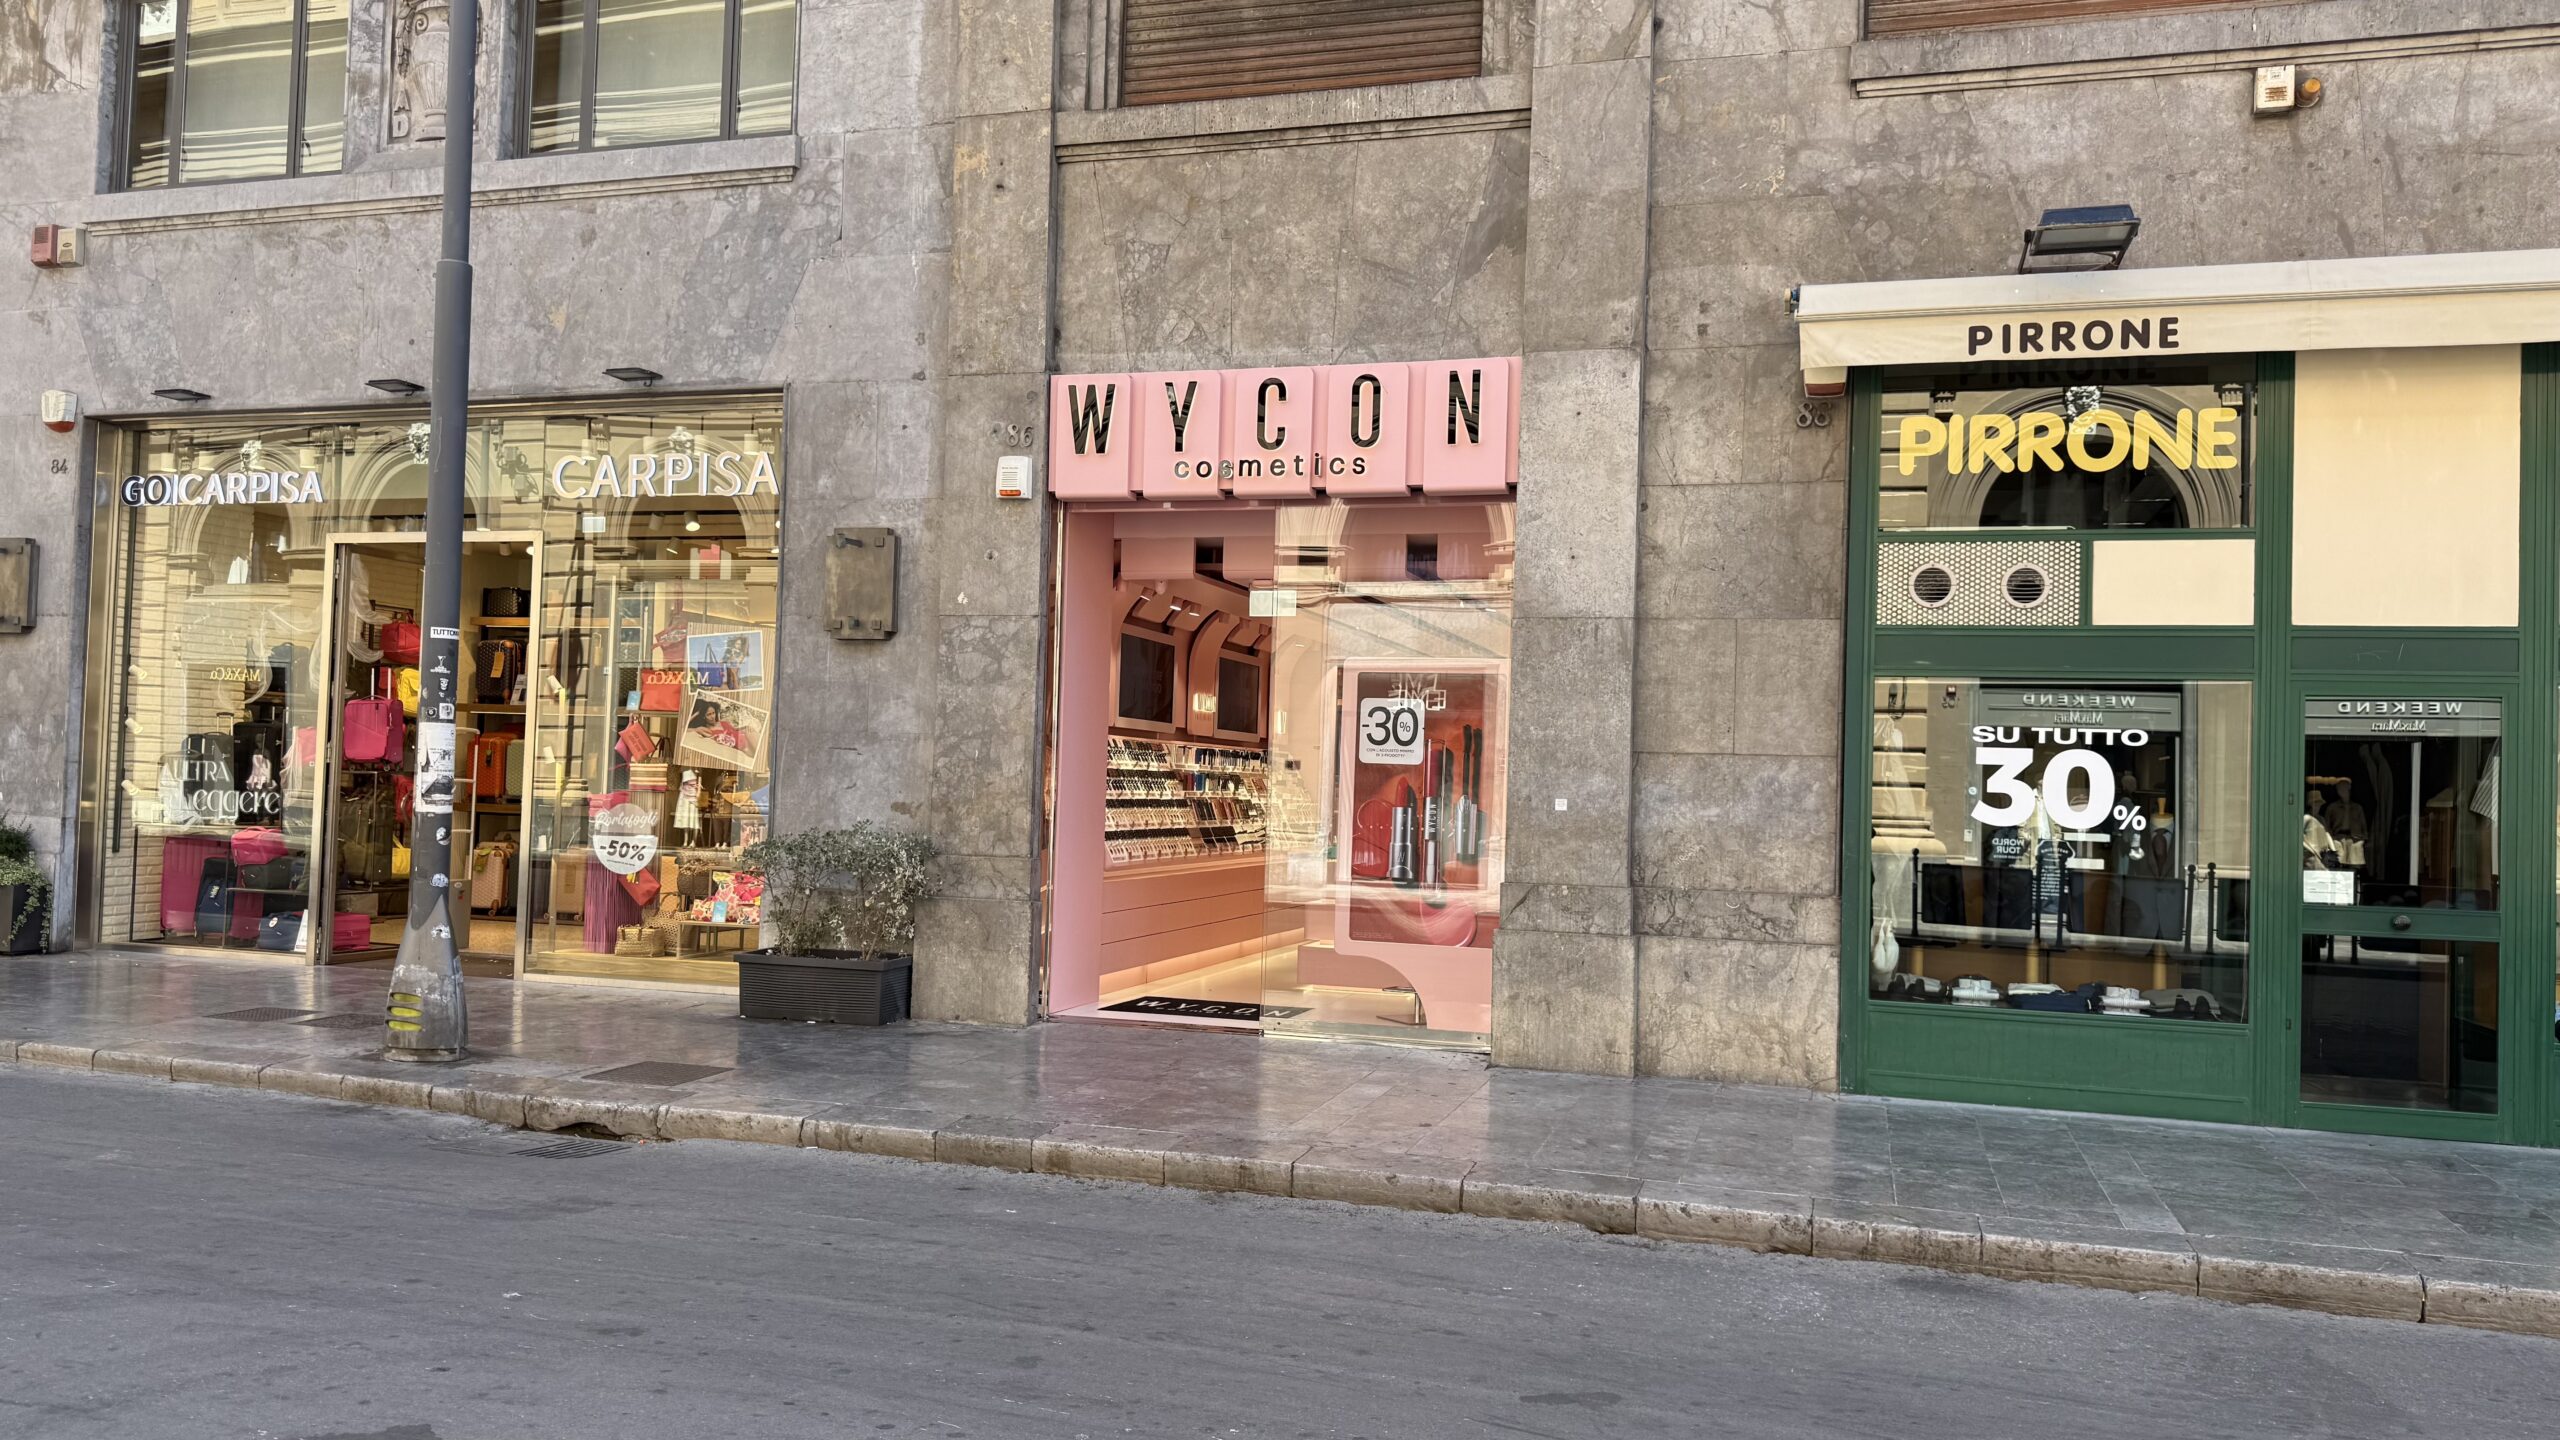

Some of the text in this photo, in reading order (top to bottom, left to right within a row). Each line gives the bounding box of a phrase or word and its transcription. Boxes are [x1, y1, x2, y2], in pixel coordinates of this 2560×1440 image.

[1968, 317, 2179, 356] PIRRONE
[1067, 369, 1481, 455] WYCON
[1007, 424, 1033, 447] 86
[1899, 407, 2238, 476] PIRRONE
[51, 458, 68, 474] 84
[552, 451, 779, 499] CARPISA
[1174, 453, 1367, 481] cosmetics
[1972, 726, 2149, 747] SU TUTTO
[172, 760, 230, 782] ULTRA
[178, 779, 281, 820] Leggere
[599, 840, 647, 861] -50%
[1135, 1000, 1290, 1017] WYCON
